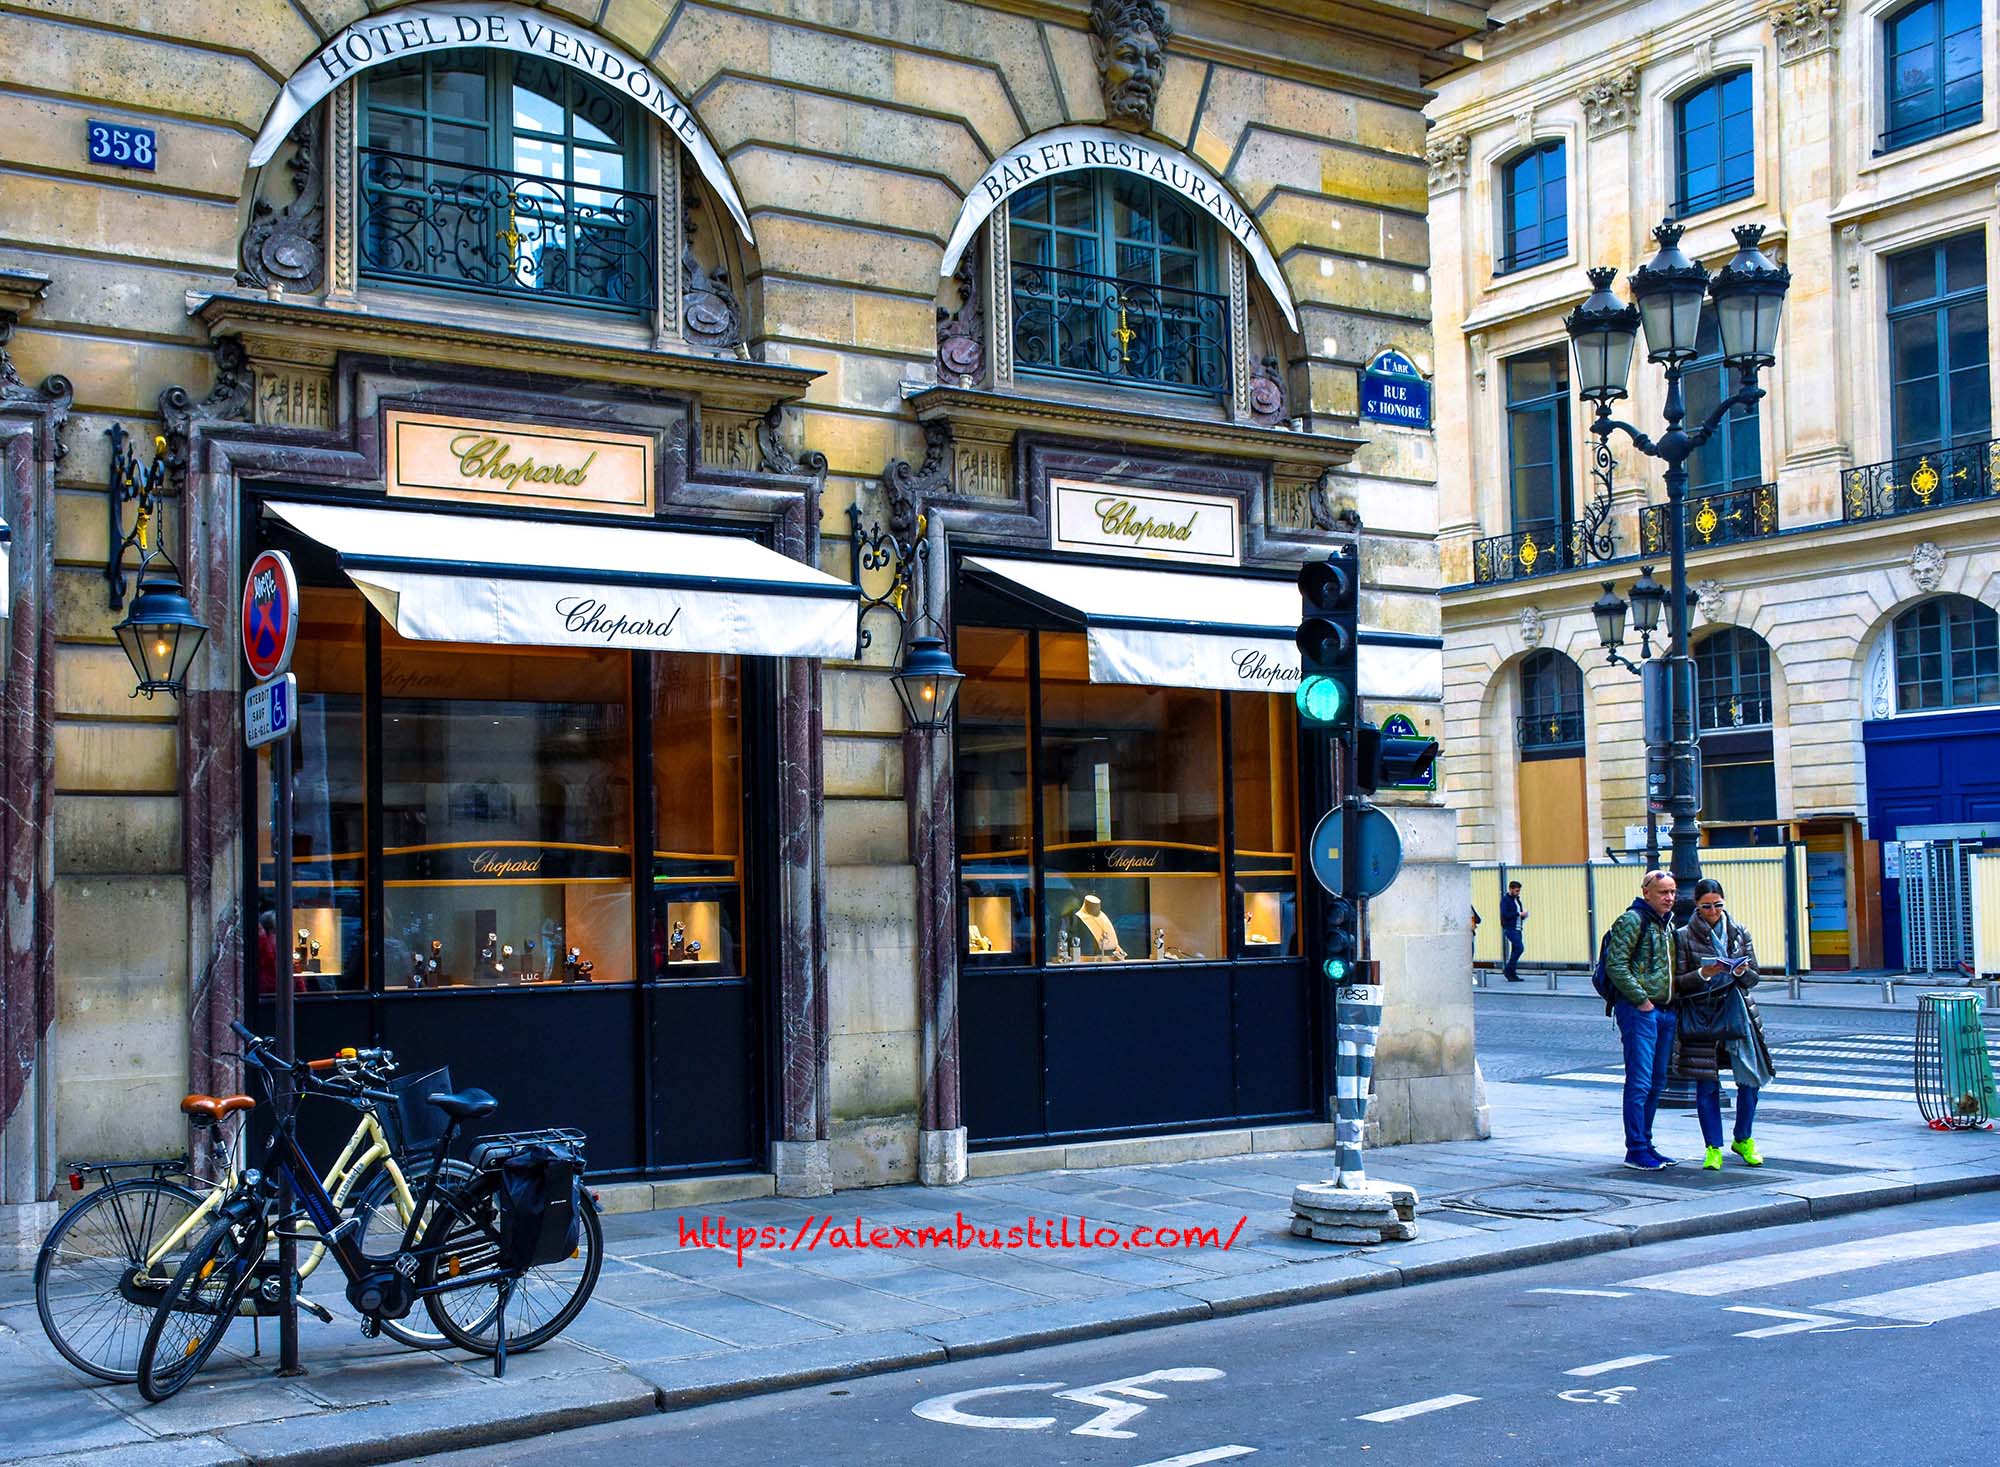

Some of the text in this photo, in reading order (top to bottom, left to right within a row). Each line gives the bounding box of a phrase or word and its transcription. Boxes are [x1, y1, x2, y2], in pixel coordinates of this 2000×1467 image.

[316, 17, 447, 83] HÔTEL
[452, 15, 509, 42] DE
[518, 19, 700, 144] VENDÔME
[93, 128, 152, 163] 358
[982, 140, 1257, 244] BAR ET RESTAURANT
[1384, 385, 1407, 401] RUE
[450, 434, 599, 490] Chopard
[1095, 498, 1198, 544] Chopard
[555, 596, 681, 641] Chopard
[1231, 649, 1302, 686] Chopar
[248, 689, 270, 707] INTERDIT
[252, 707, 265, 722] SAUF
[468, 849, 544, 877] Chopard
[1104, 847, 1159, 871] Chopard
